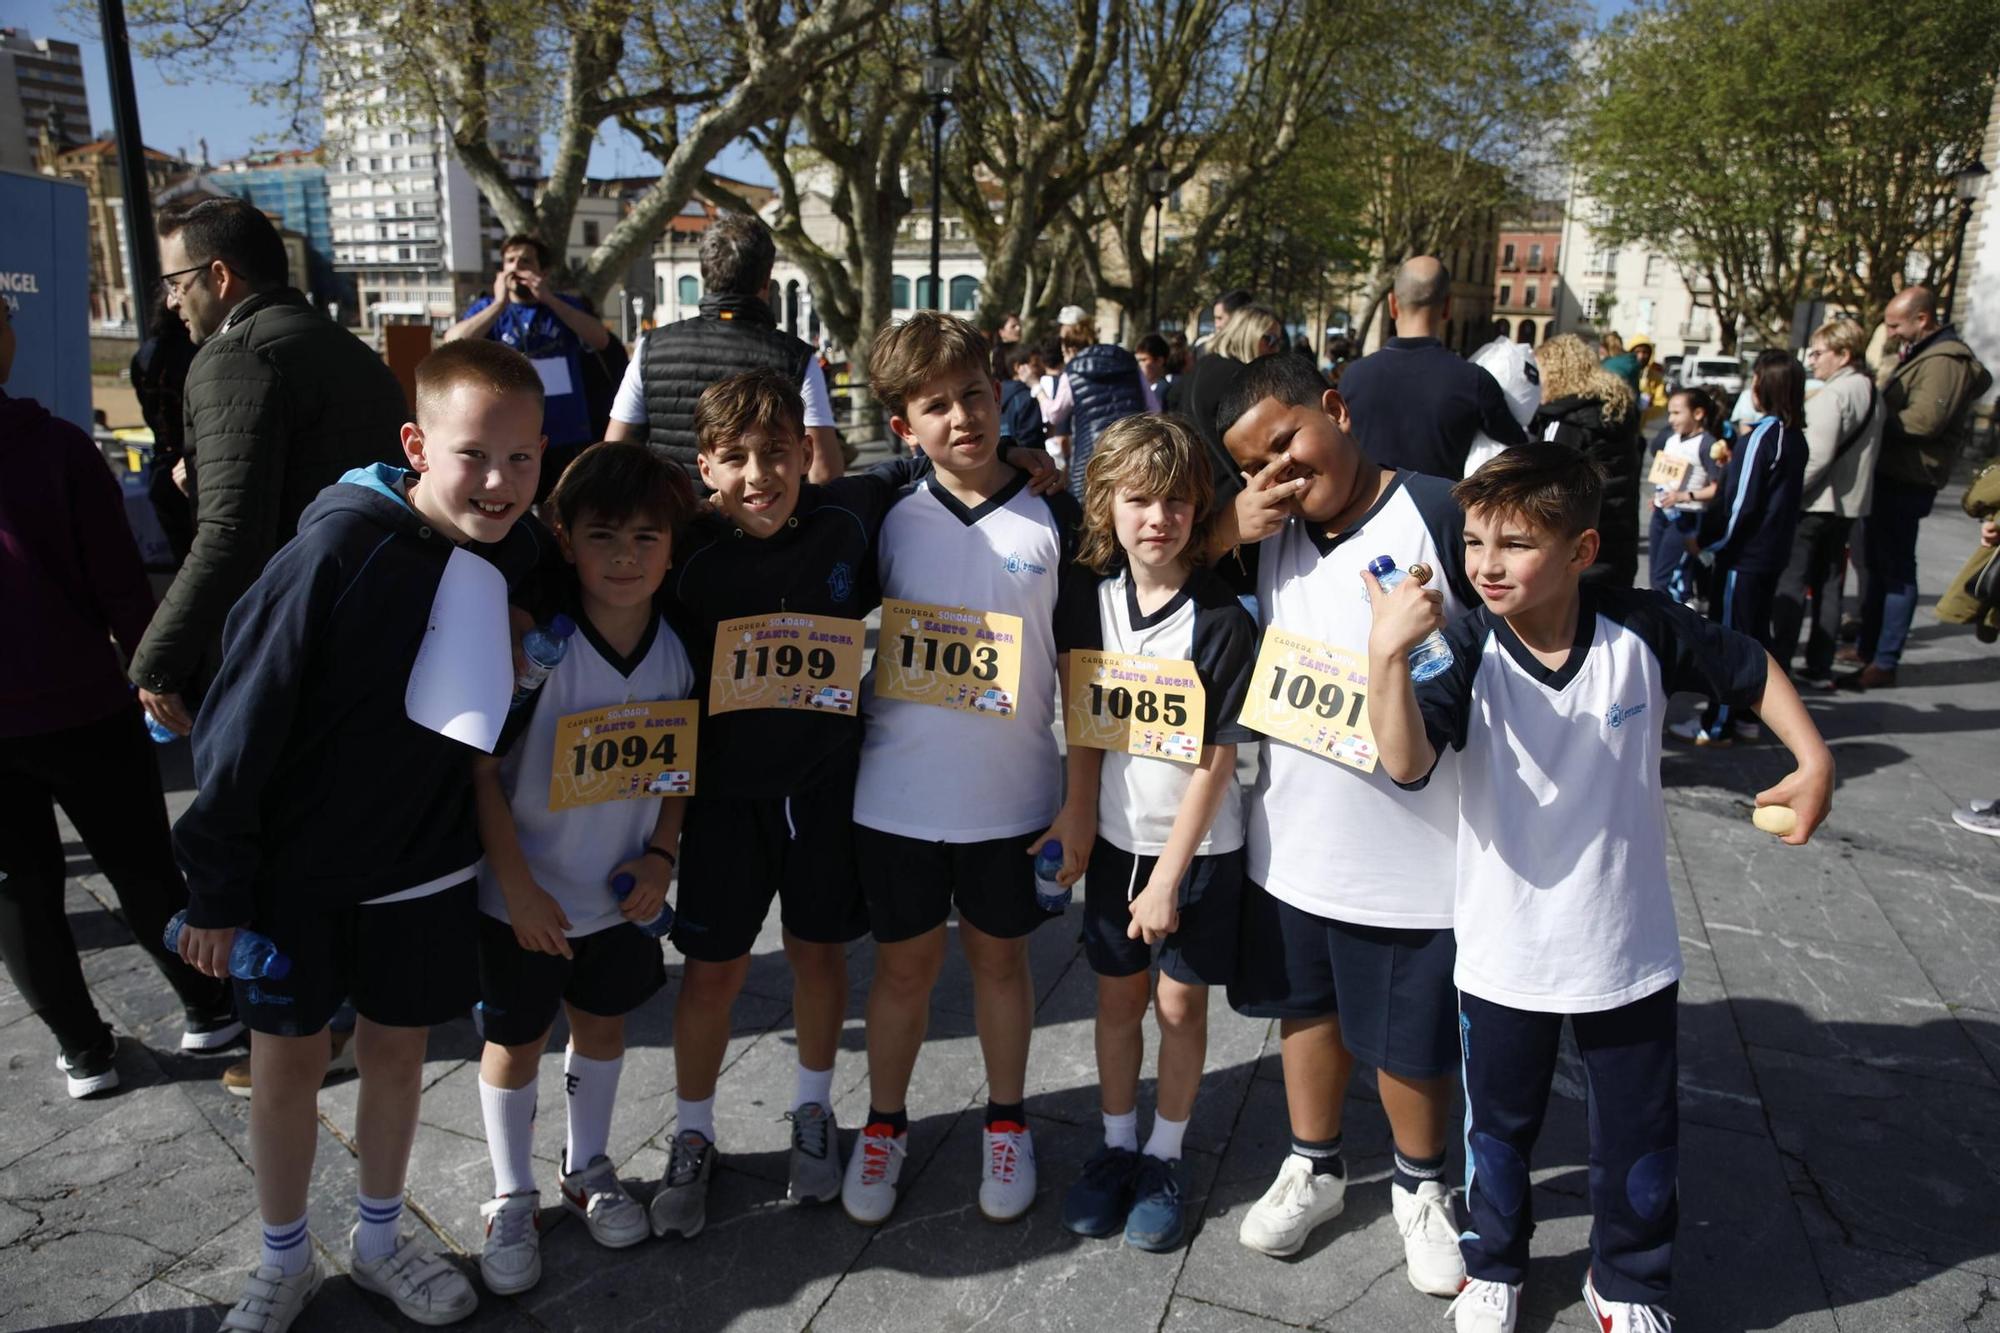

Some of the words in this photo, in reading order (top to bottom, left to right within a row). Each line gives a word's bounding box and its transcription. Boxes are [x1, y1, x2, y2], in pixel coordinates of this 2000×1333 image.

[727, 622, 766, 632] CARRERA
[892, 607, 934, 618] CARRERA
[938, 610, 982, 624] SOLIDARIA
[900, 634, 999, 681] 1103
[1274, 636, 1312, 654] CARRERA
[733, 645, 836, 680] 1199
[1081, 656, 1120, 666] CARRERA
[1089, 683, 1187, 727] 1085
[1269, 665, 1366, 728] 1091
[568, 714, 605, 729] CARRERA
[607, 707, 650, 720] SOLIDARIA
[573, 733, 677, 776] 1094
